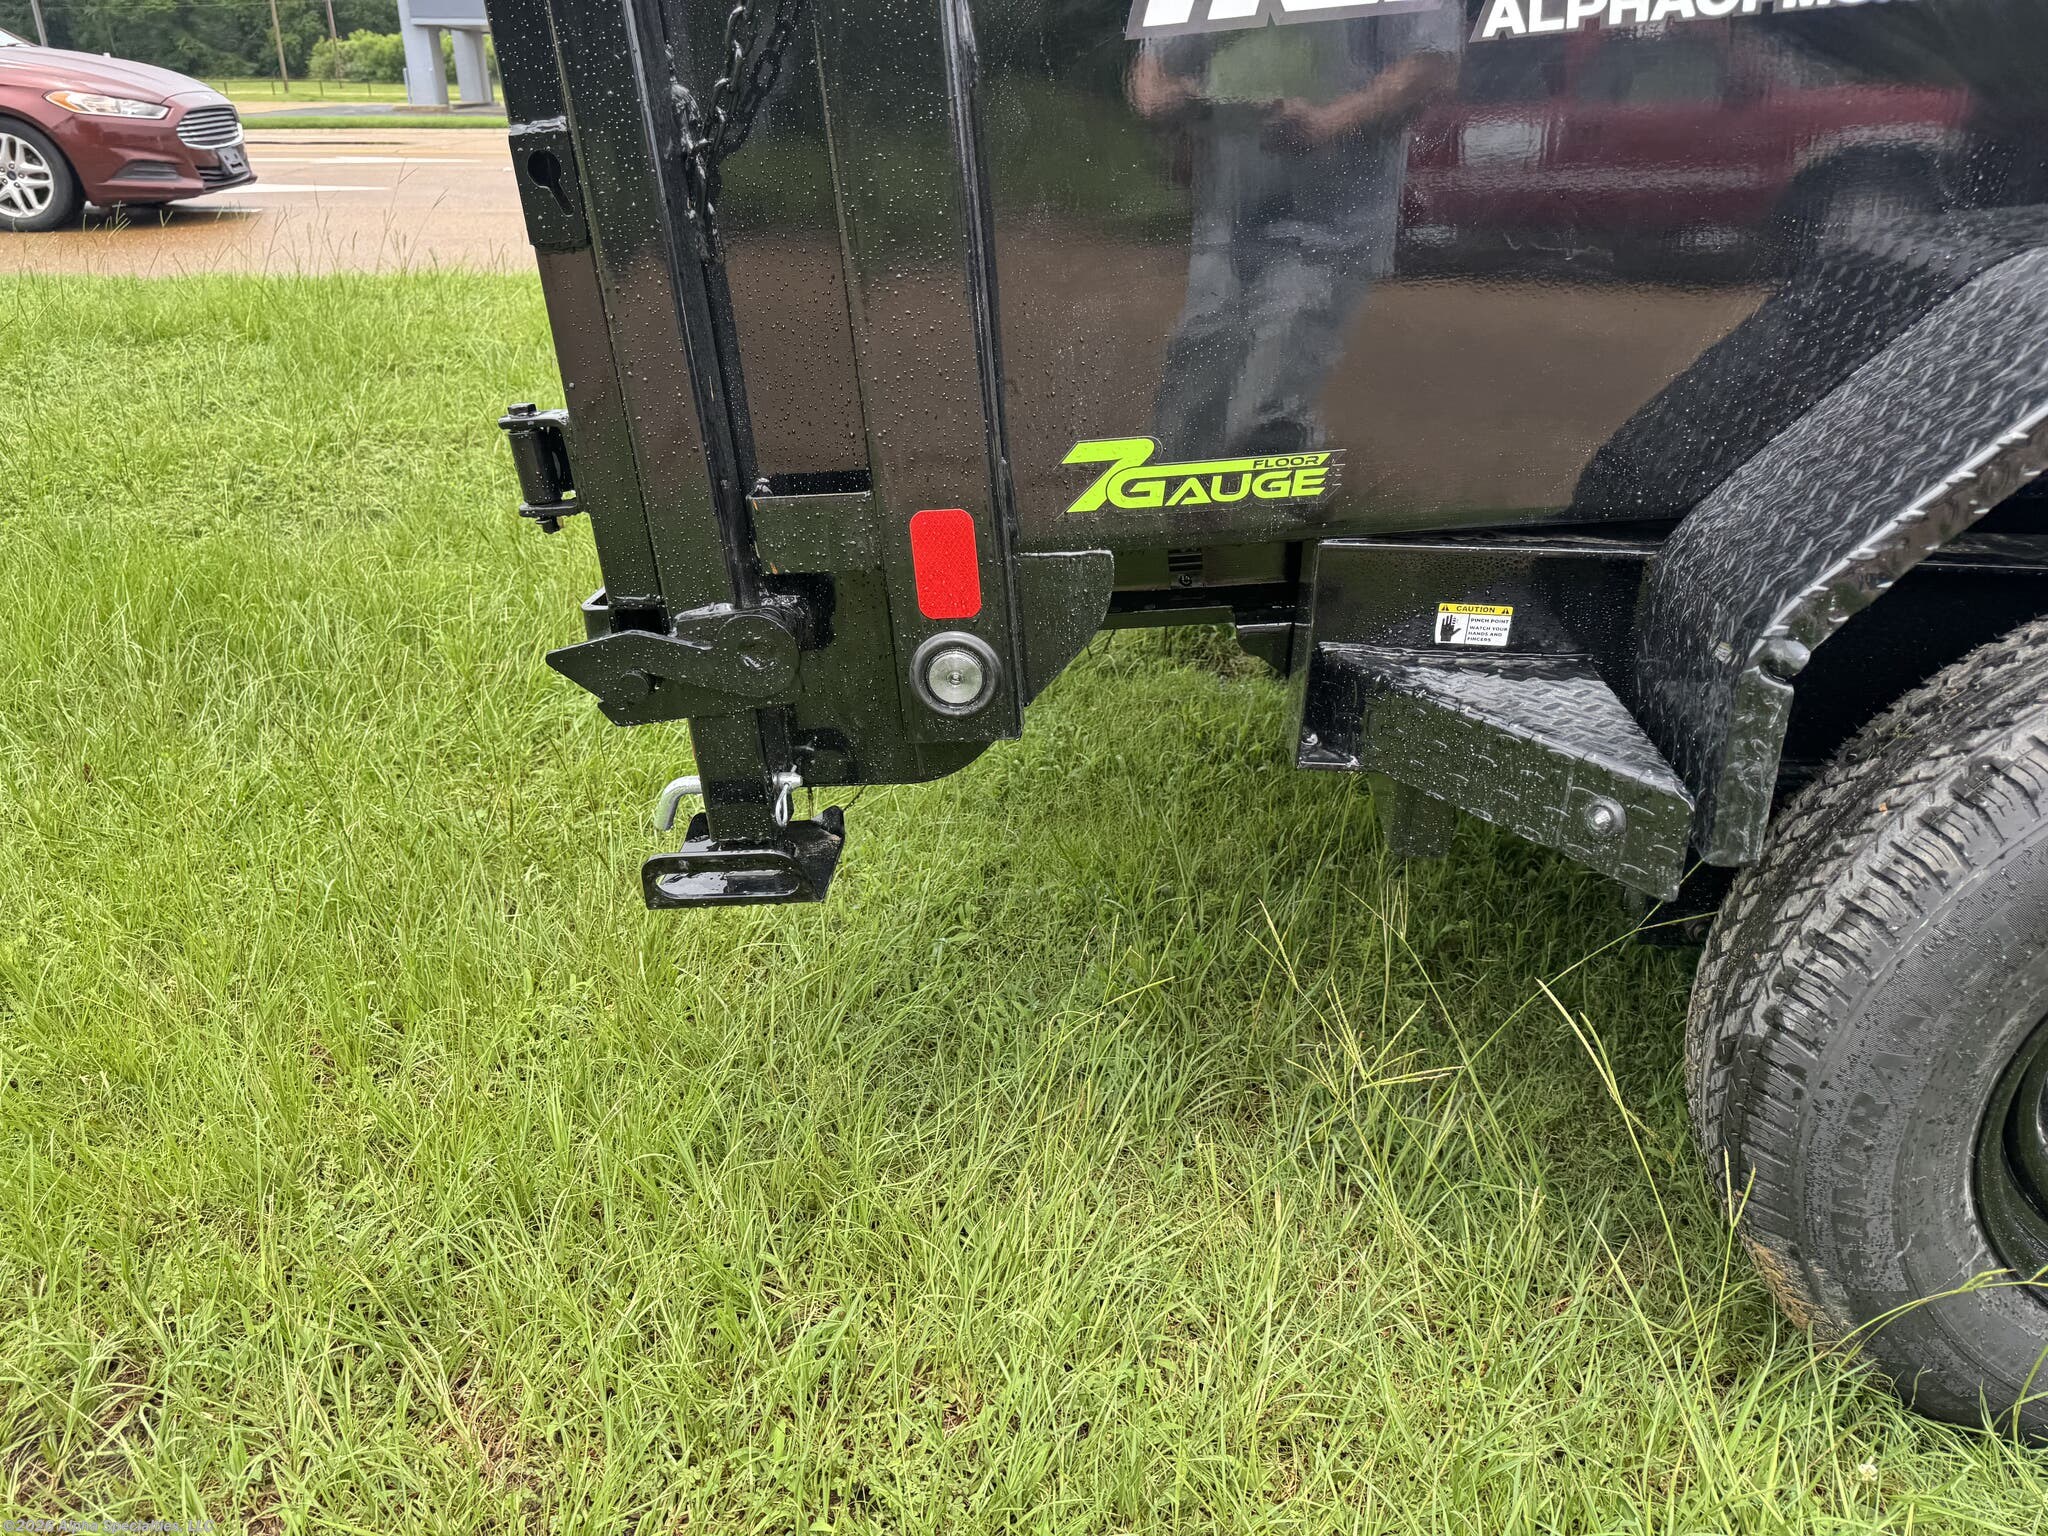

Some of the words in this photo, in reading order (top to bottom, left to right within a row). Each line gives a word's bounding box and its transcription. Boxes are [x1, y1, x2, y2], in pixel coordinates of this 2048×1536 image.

[1062, 438, 1155, 513] 7
[1252, 455, 1320, 470] FLOOR
[1107, 466, 1330, 509] GAUGE
[1456, 605, 1496, 613] CAUTION
